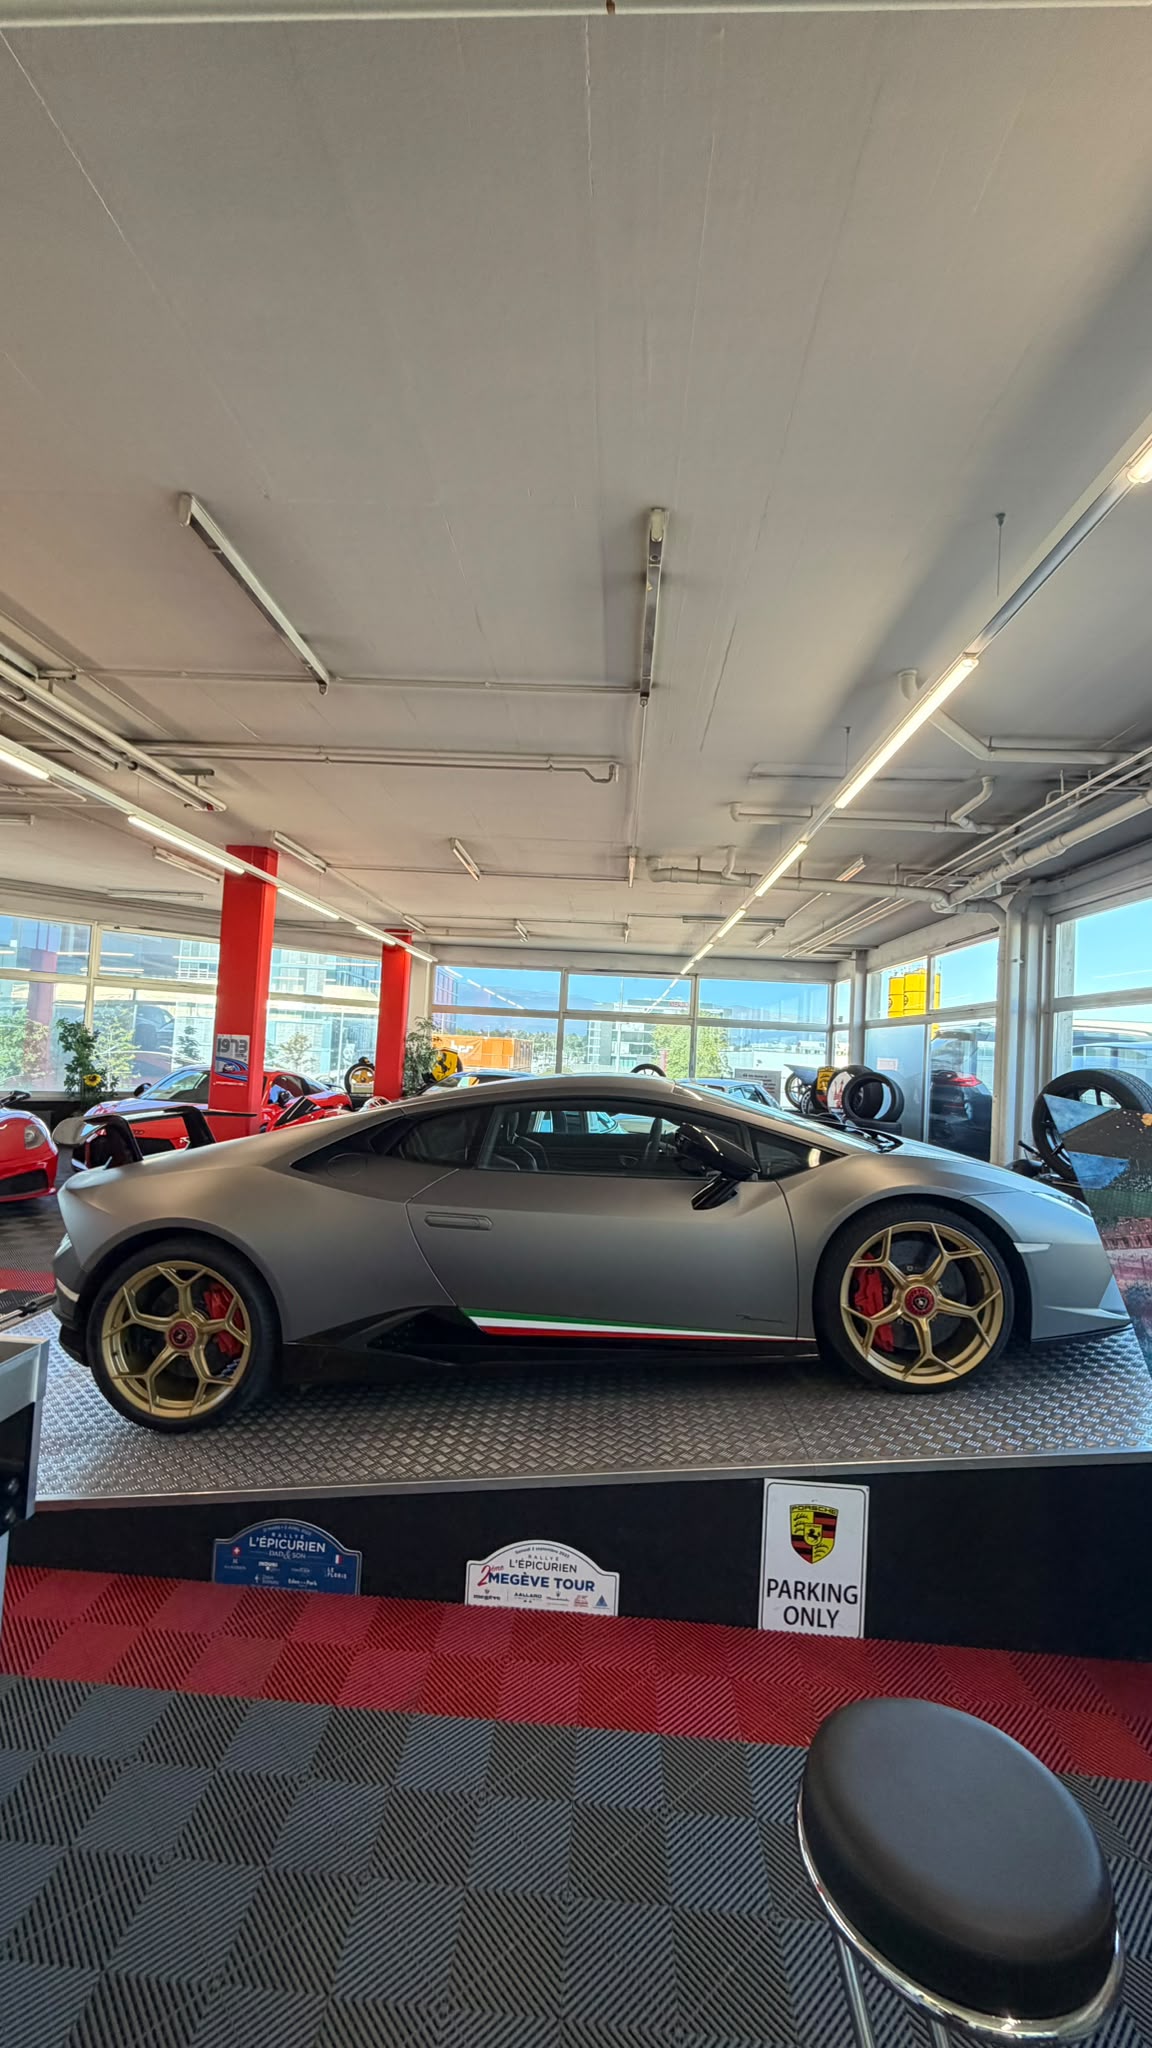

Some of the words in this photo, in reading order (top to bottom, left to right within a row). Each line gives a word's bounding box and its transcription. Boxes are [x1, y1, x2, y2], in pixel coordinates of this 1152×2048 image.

[217, 1038, 248, 1054] 1973
[791, 1504, 838, 1515] PORSCHE
[271, 1532, 305, 1540] RALLYE
[249, 1536, 326, 1553] L'ÉPICURIEN
[509, 1558, 577, 1573] L'ÉPICURIEN
[528, 1554, 559, 1562] RALLYE
[488, 1571, 550, 1588] MEGÈVE
[554, 1578, 595, 1592] TOUR
[767, 1578, 859, 1605] PARKING
[783, 1605, 840, 1630] ONLY
